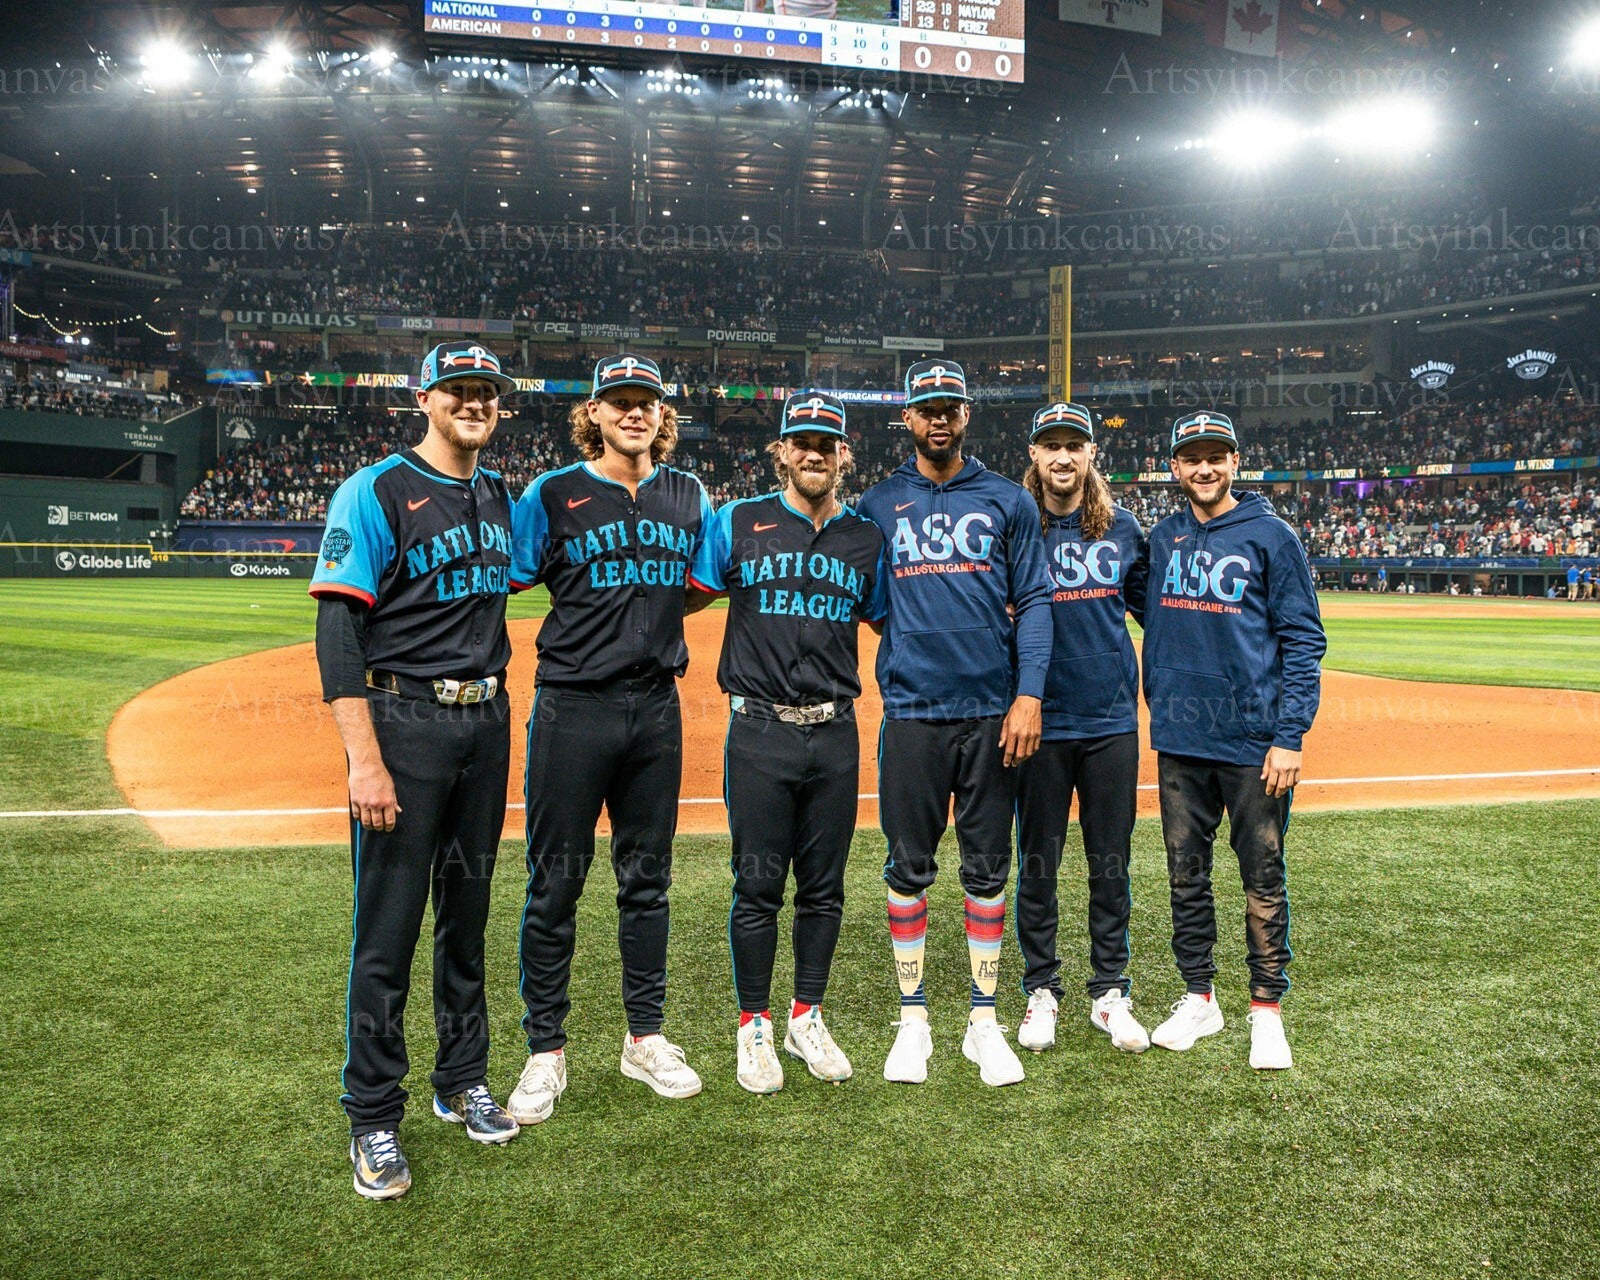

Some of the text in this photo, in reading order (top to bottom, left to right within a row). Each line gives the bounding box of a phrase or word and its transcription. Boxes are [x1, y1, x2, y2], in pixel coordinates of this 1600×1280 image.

[958, 5, 996, 21] NAYLOR
[432, 2, 888, 51] NATIONAL 0 0 3 0 0 0 0 0 0 3 10 0
[918, 16, 988, 35] 13 C PEREZ
[432, 18, 888, 66] AMERICAN 0 0 3 0 2 0 0 0 5 5 0
[915, 47, 1011, 76] 0 0 0
[237, 311, 357, 327] UT DALLAS
[402, 318, 433, 329] 105.3
[544, 322, 574, 333] PGL
[708, 329, 776, 343] POWERADE
[825, 336, 840, 344] Real
[858, 337, 880, 345] know.
[468, 346, 486, 369] P
[1507, 349, 1558, 369] JACK DANIEL'S
[621, 357, 639, 377] P
[1410, 362, 1428, 379] JACK
[356, 374, 409, 387] AL WINS!
[930, 366, 946, 387] P
[862, 393, 883, 401] GAME
[808, 398, 824, 419] P
[1052, 404, 1068, 421] P
[1194, 415, 1210, 433] P
[124, 432, 164, 442] TEREMANA
[1514, 458, 1555, 470] AL WINS!
[1240, 471, 1264, 481] WINS!
[1323, 468, 1356, 480] AL WINS!
[69, 511, 118, 522] BETMGM
[891, 512, 994, 566] ASG
[78, 554, 152, 569] Globe Life
[946, 563, 975, 574] GAME
[1048, 540, 1121, 589] SG
[249, 565, 290, 576] Kubota
[590, 560, 686, 588] LEAGUE
[1162, 550, 1251, 602] ASG
[1080, 588, 1107, 599] GAME
[759, 589, 855, 622] LEAGUE
[1199, 601, 1224, 614] GAME
